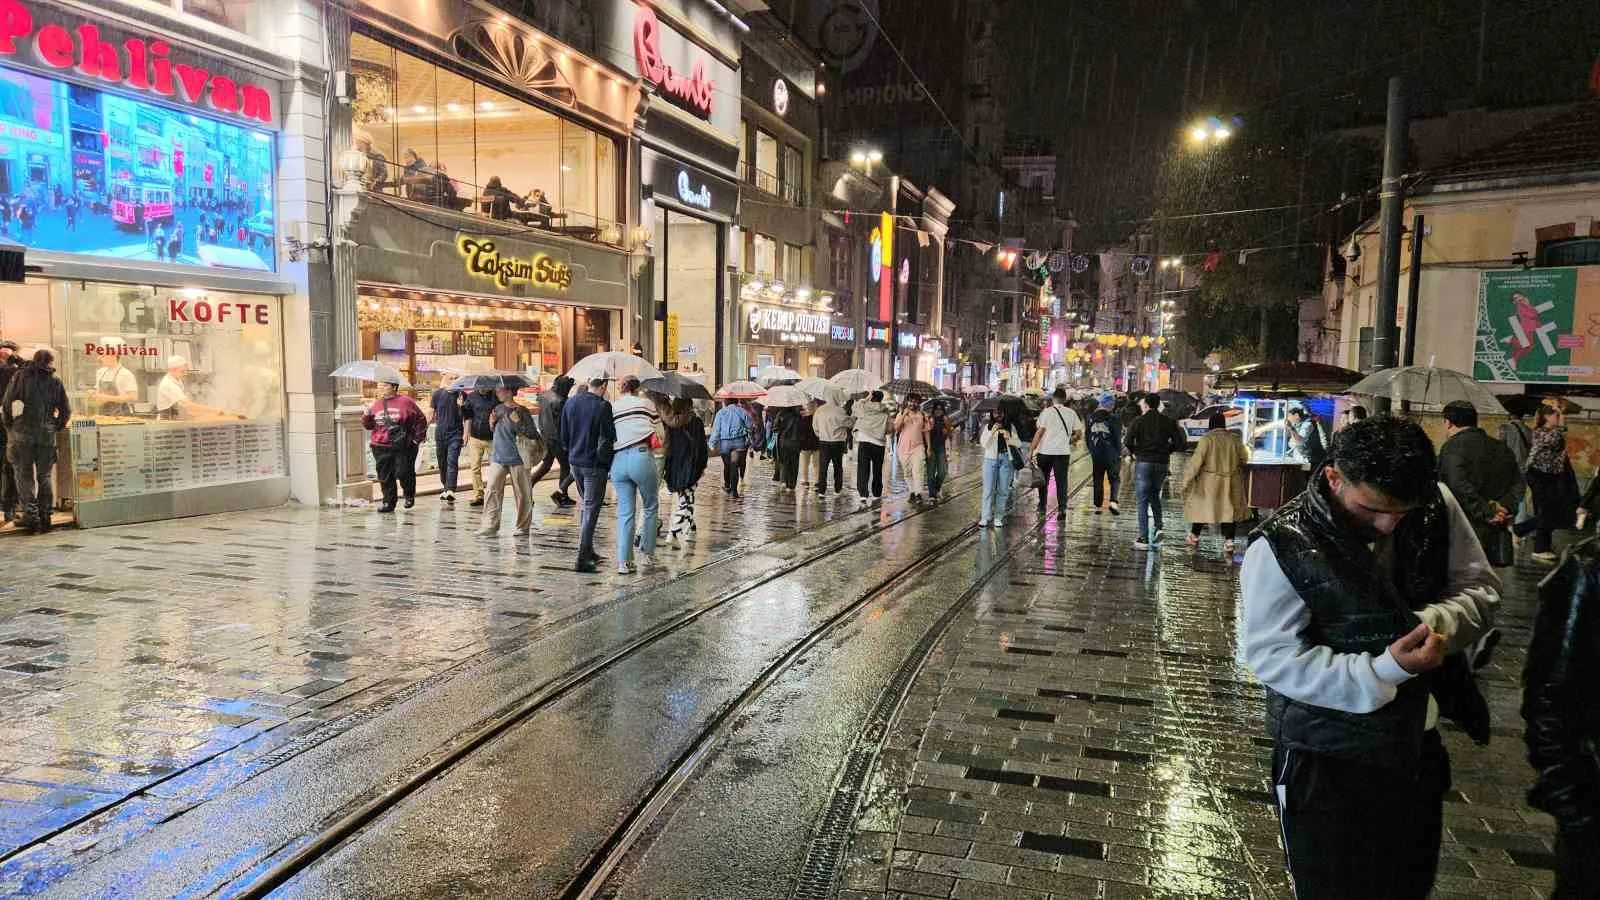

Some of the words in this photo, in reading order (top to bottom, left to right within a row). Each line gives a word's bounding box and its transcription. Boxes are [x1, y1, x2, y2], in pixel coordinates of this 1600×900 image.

[0, 0, 273, 122] Pehlivan
[461, 238, 532, 287] Taksim
[169, 296, 269, 325] KÖFTE
[764, 309, 793, 331] KEBAP
[84, 343, 160, 356] Pehlivan
